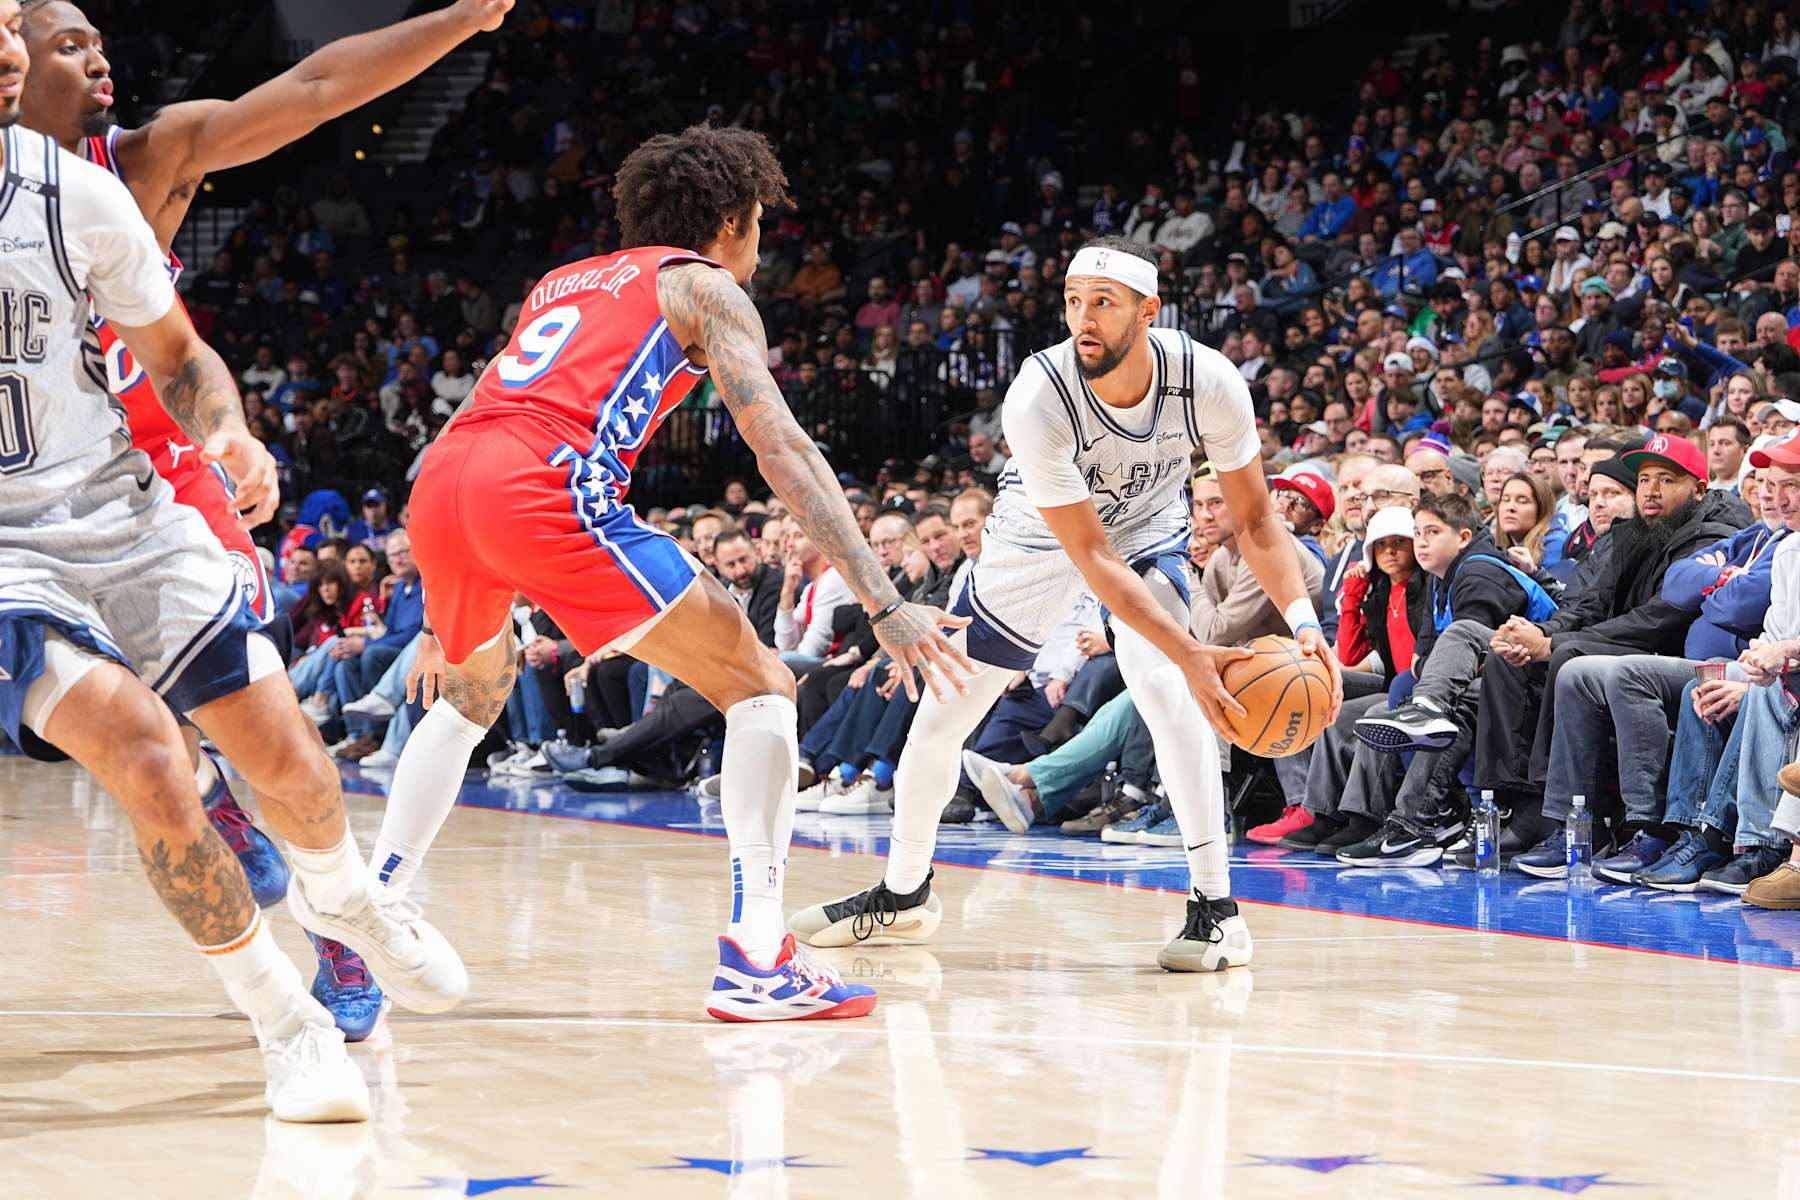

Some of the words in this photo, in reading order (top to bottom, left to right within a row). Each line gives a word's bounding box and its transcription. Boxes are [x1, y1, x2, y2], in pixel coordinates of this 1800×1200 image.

[21, 178, 42, 192] PW
[0, 236, 45, 253] Disney
[497, 305, 581, 388] 9
[1167, 387, 1181, 396] PW
[1156, 432, 1184, 445] Disney
